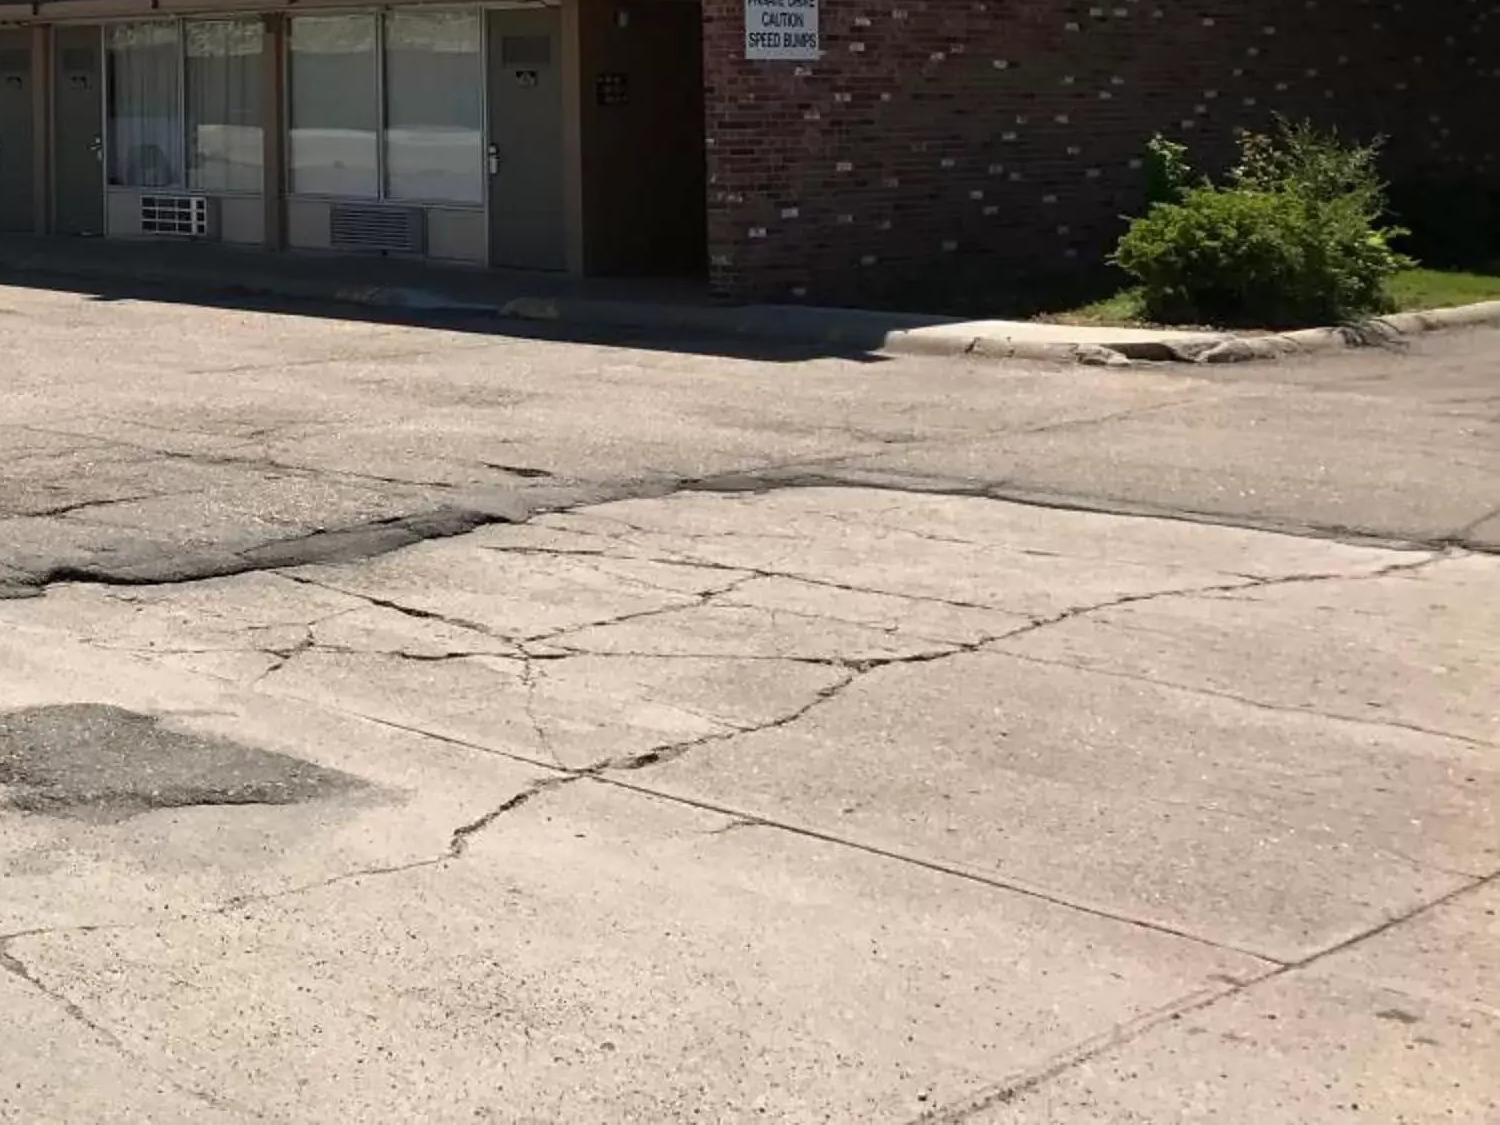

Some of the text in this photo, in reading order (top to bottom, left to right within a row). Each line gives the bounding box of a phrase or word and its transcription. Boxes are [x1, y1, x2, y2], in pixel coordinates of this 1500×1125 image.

[762, 12, 804, 28] CAUTION
[748, 32, 816, 48] SPEED BUMPS
